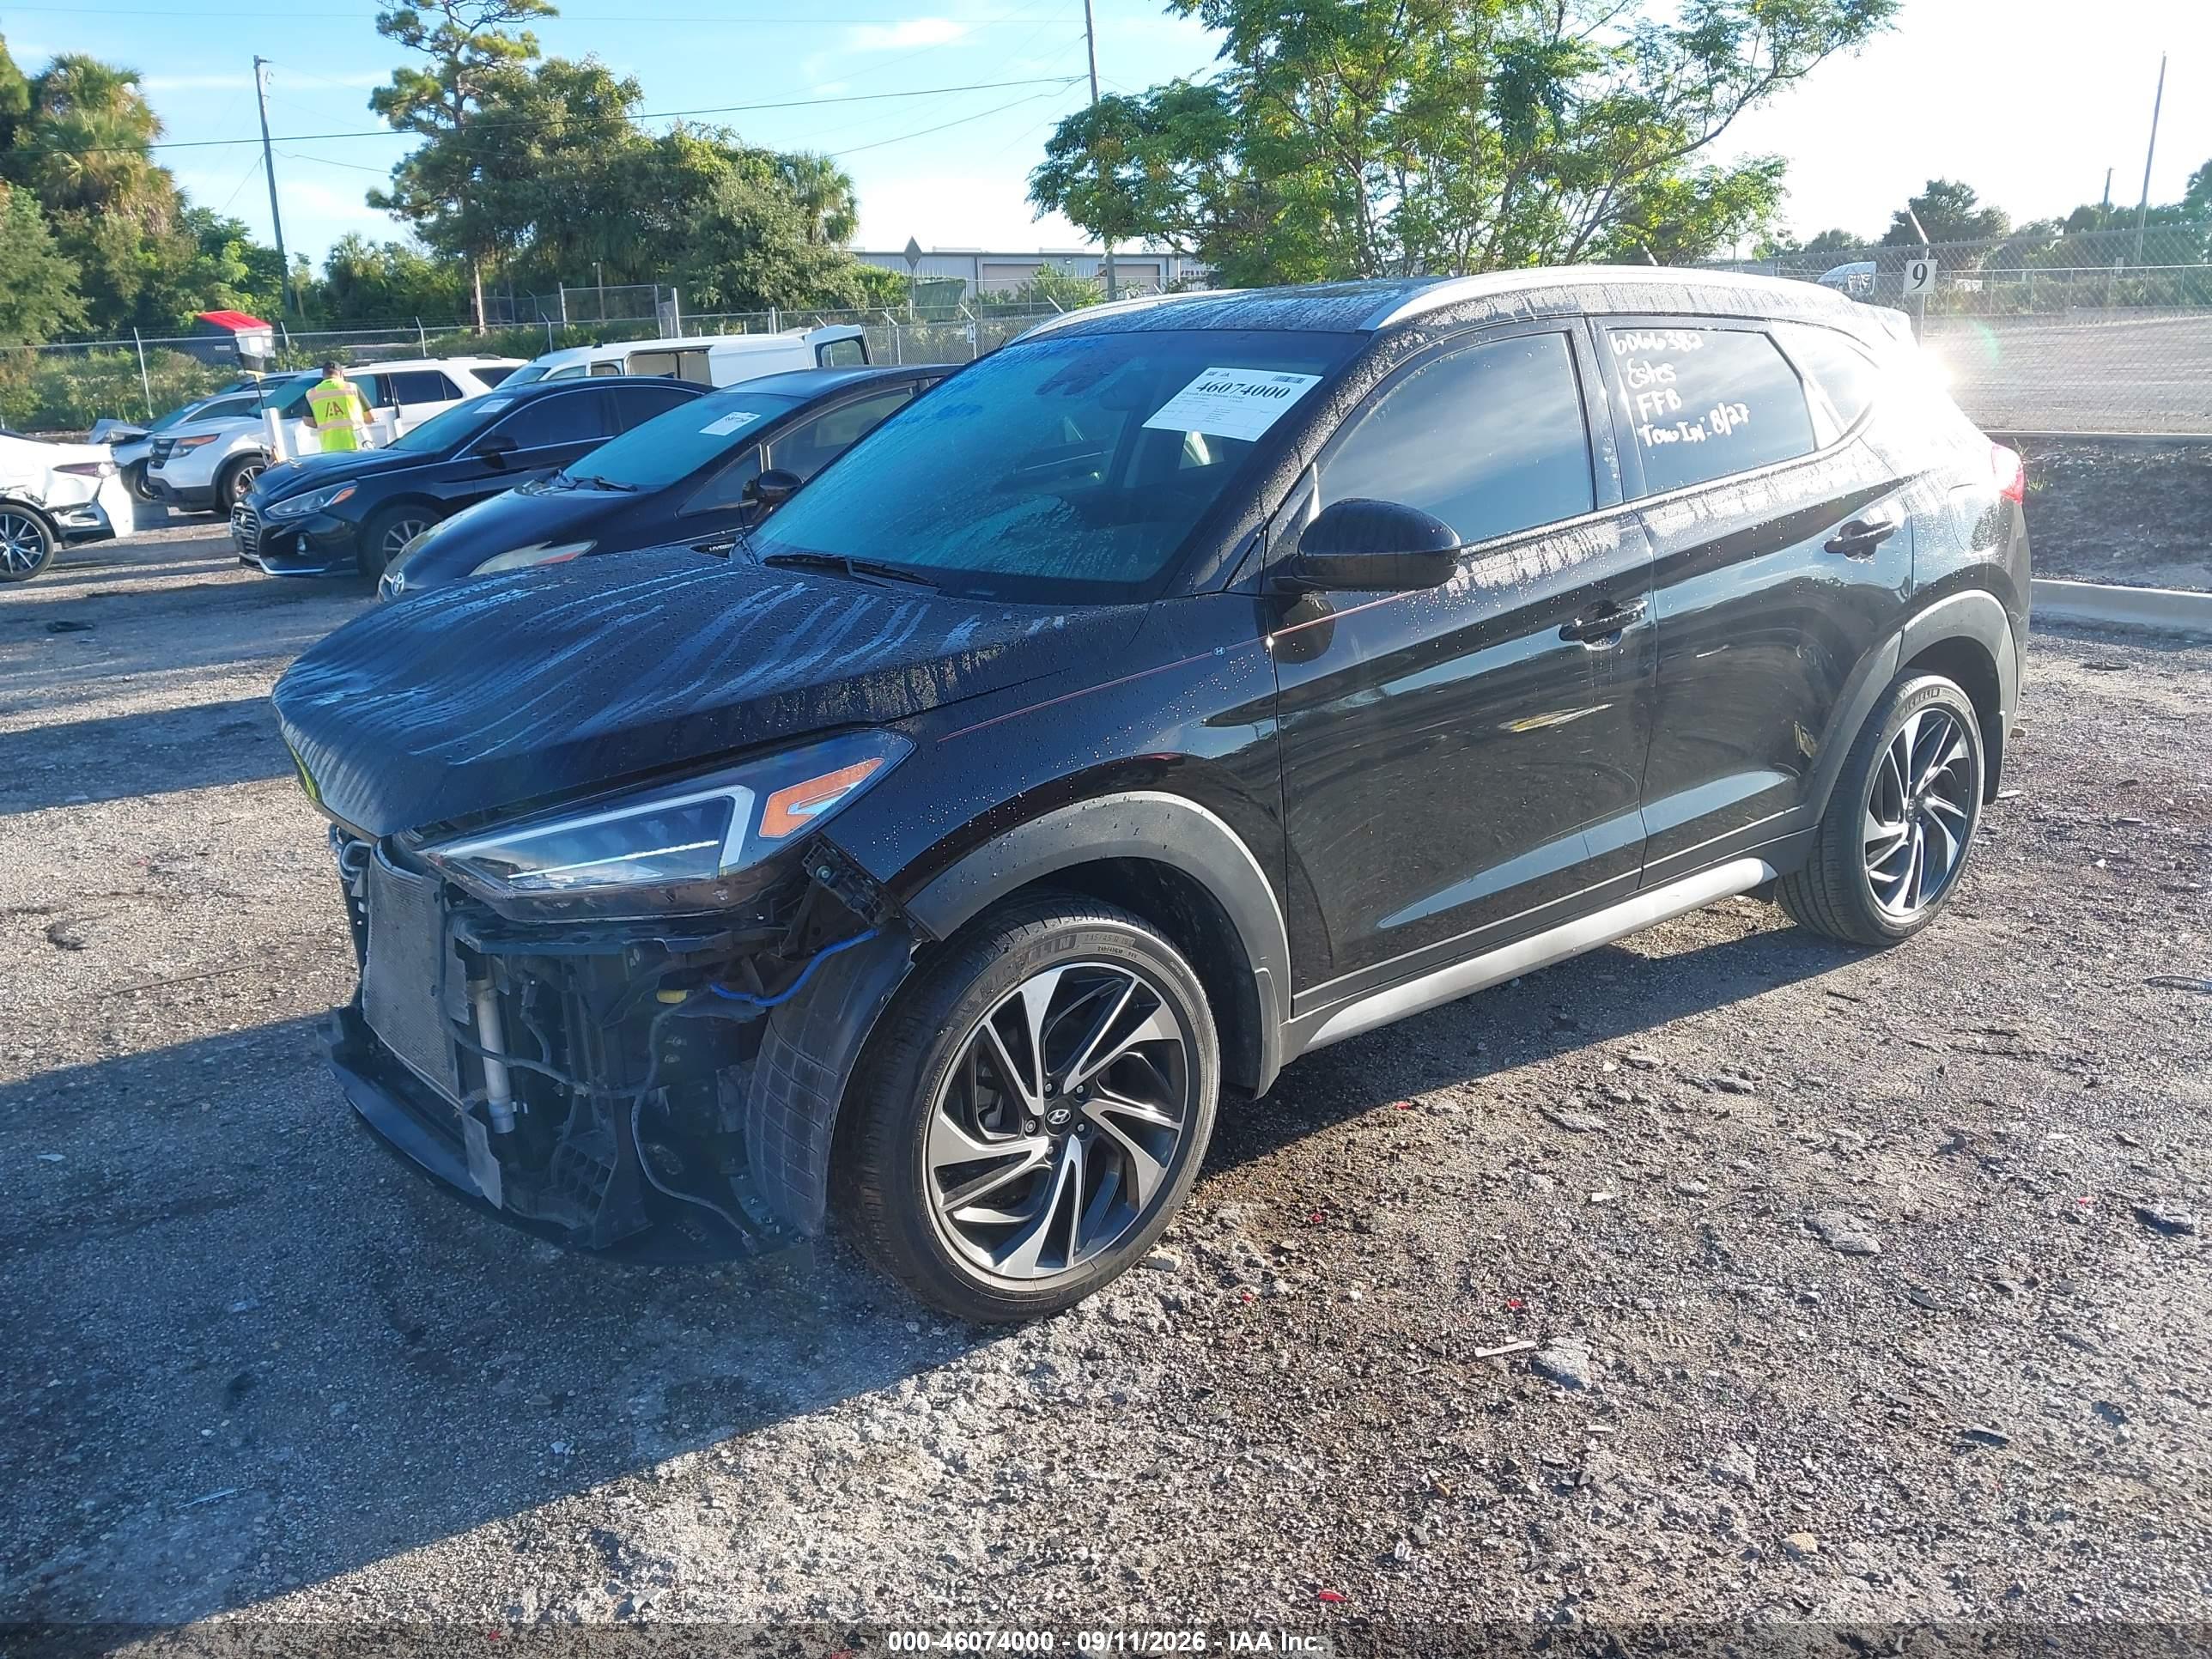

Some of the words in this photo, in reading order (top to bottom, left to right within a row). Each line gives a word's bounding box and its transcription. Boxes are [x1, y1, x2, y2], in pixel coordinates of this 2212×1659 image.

[1911, 263, 1929, 290] 9
[1196, 380, 1291, 399] 46074000
[1636, 387, 1683, 422] FFB
[1709, 402, 1750, 436] 8/27
